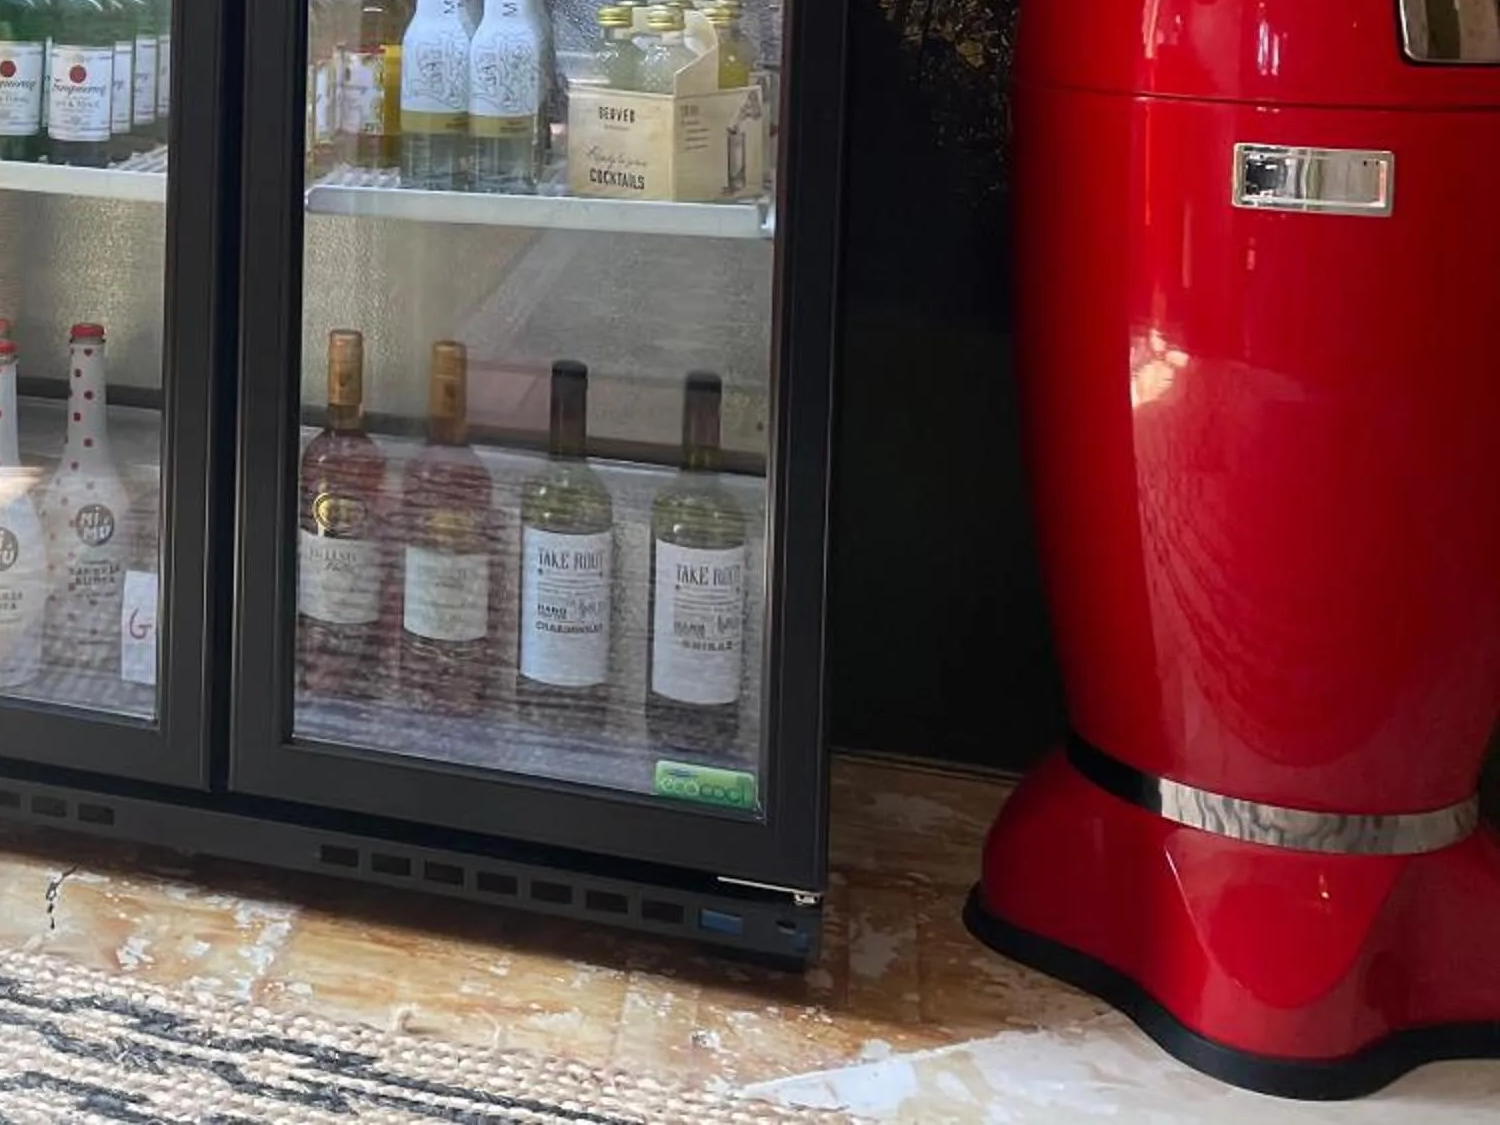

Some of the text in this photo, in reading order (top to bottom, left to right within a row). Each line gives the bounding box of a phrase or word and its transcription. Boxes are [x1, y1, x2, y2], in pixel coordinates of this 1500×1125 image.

[589, 167, 646, 191] COCKTAILS
[537, 547, 570, 570] TAKE
[676, 564, 709, 586] TAKE
[128, 606, 153, 641] G
